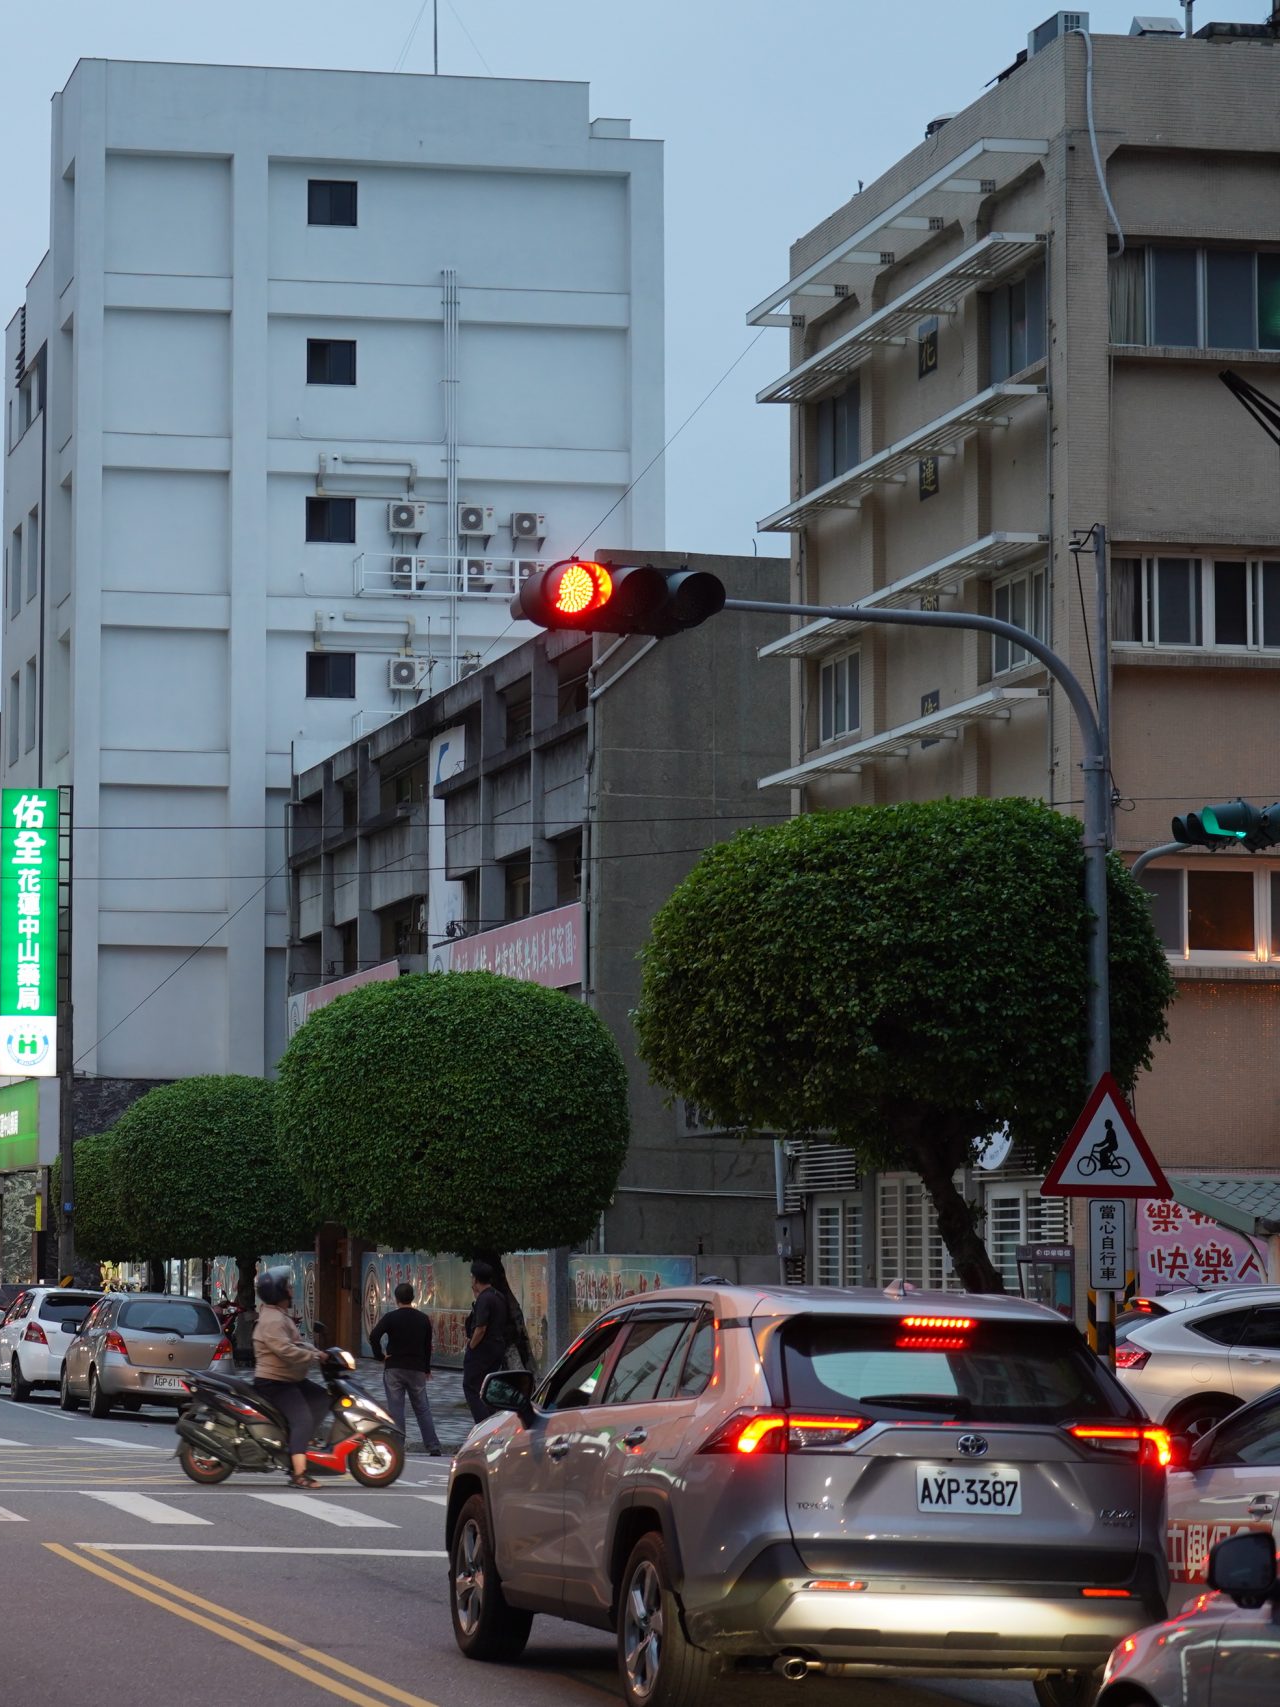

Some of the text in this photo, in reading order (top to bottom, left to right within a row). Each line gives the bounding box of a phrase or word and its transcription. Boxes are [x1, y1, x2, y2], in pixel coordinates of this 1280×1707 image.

[11, 794, 47, 1011] 佑全花蓮中山藥局
[1043, 1249, 1071, 1257] 中華電信
[1099, 1205, 1117, 1281] 當心自行車
[1167, 1523, 1250, 1580] 中興
